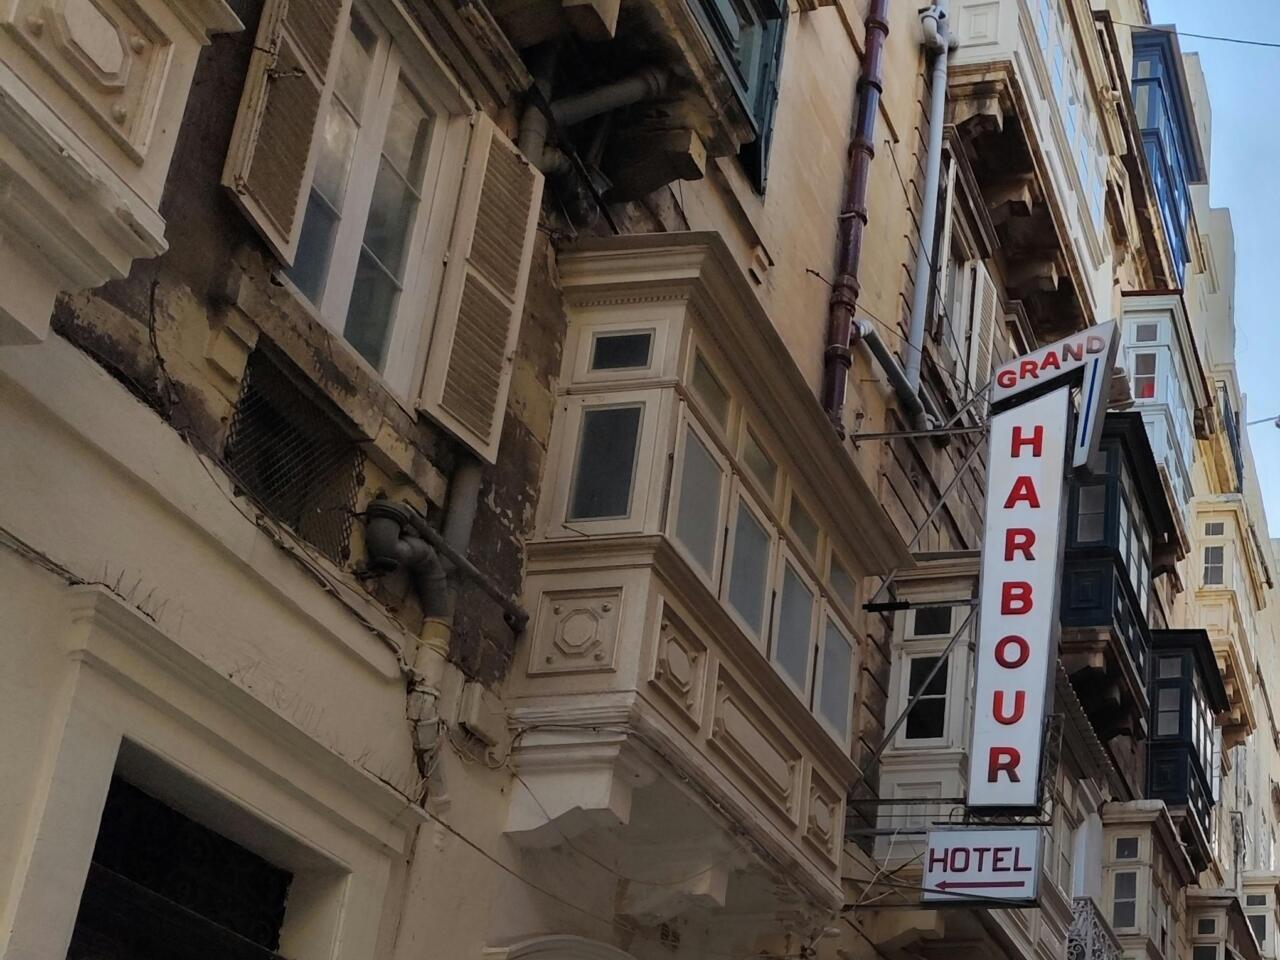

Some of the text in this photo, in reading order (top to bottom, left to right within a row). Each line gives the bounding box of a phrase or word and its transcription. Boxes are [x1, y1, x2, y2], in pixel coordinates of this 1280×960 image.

[996, 334, 1107, 389] GRAND
[986, 424, 1045, 784] HARBOUR
[927, 845, 1033, 874] HOTEL
